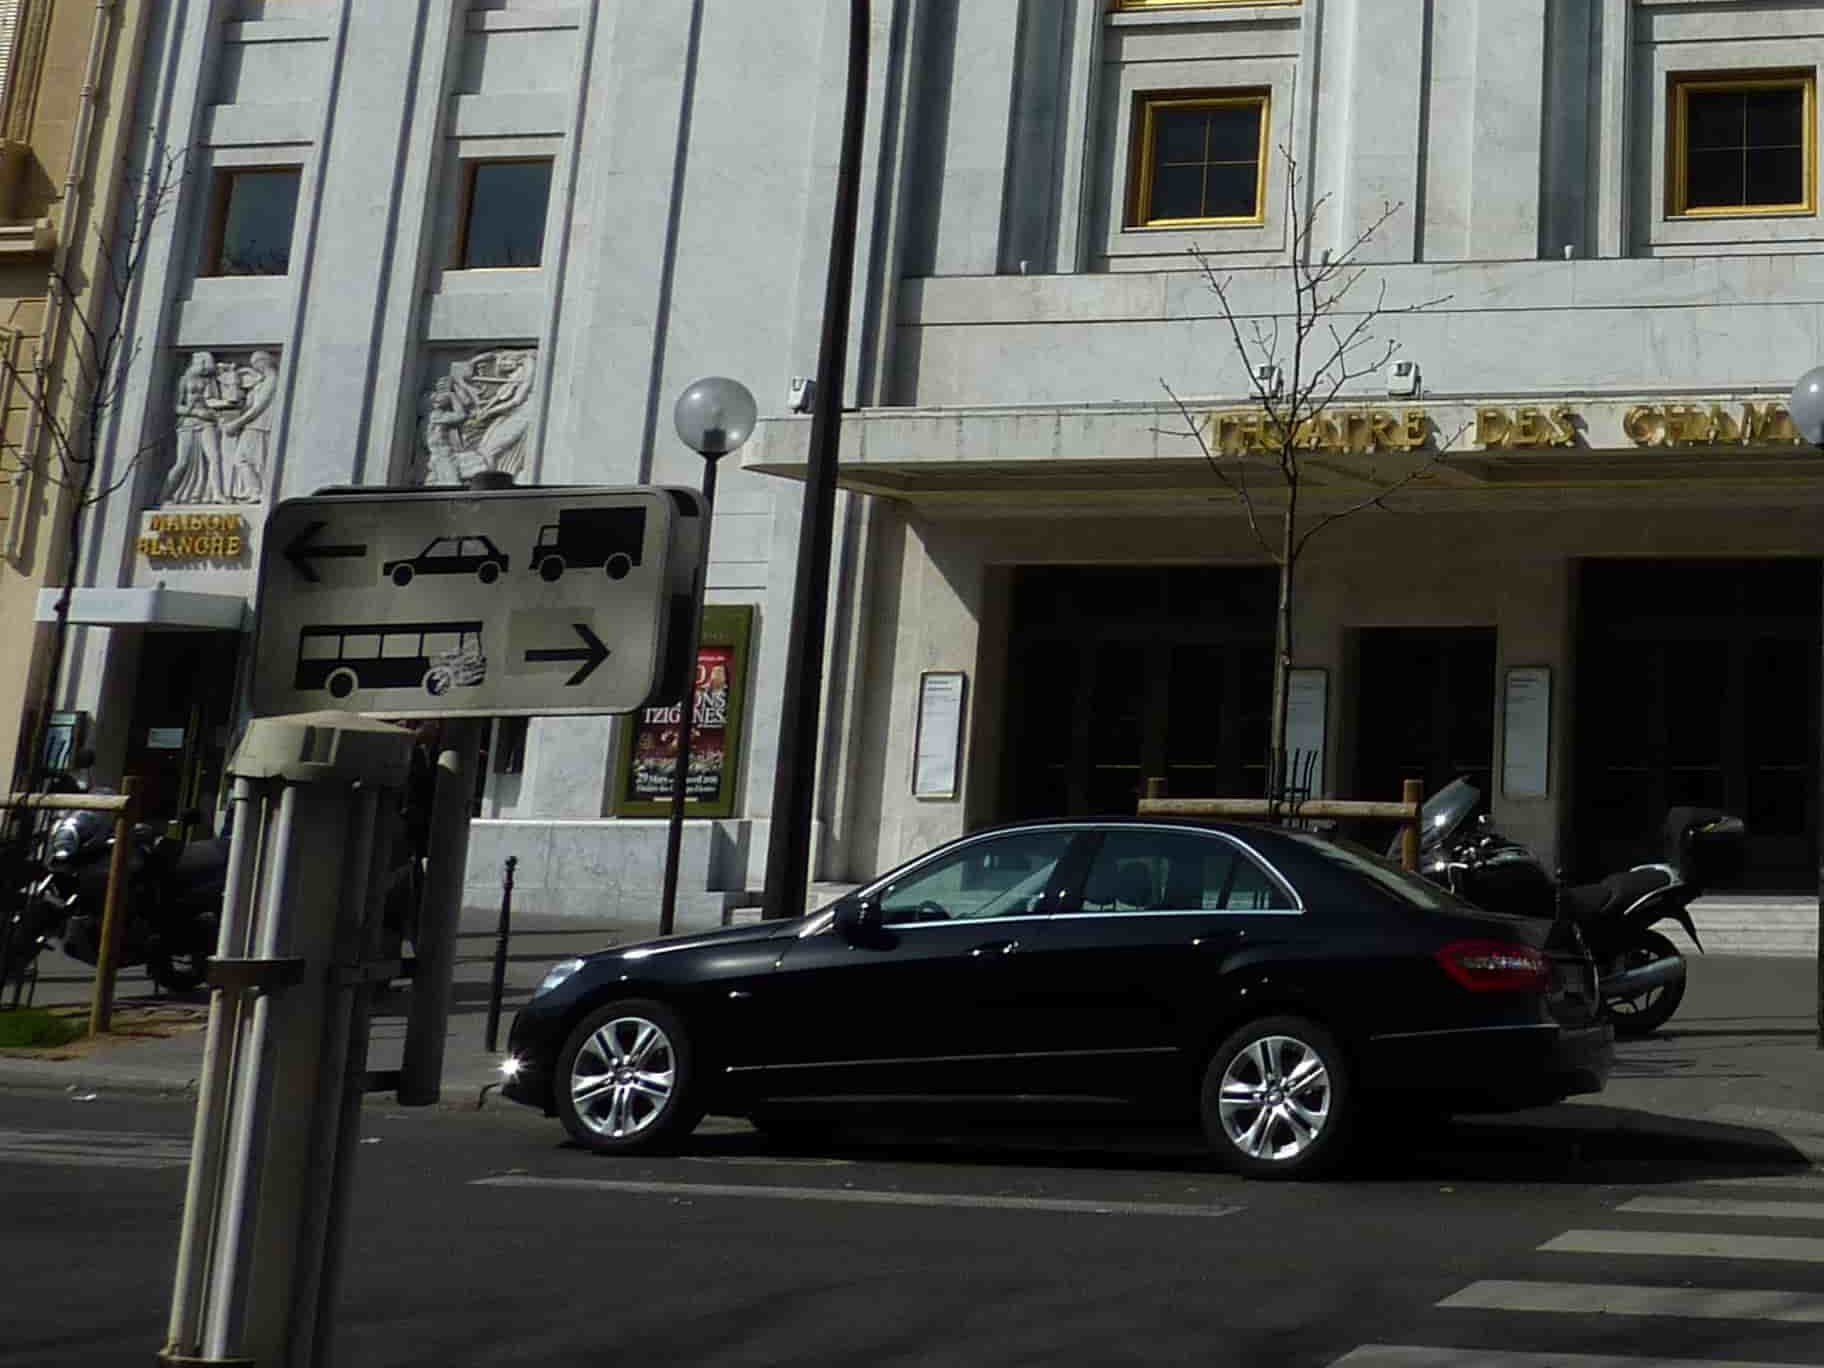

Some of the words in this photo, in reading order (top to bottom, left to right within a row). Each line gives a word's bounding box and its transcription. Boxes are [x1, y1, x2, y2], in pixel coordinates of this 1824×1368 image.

[1474, 407, 1576, 446] DES
[149, 513, 242, 532] MAISON
[136, 534, 241, 557] BLANCHE
